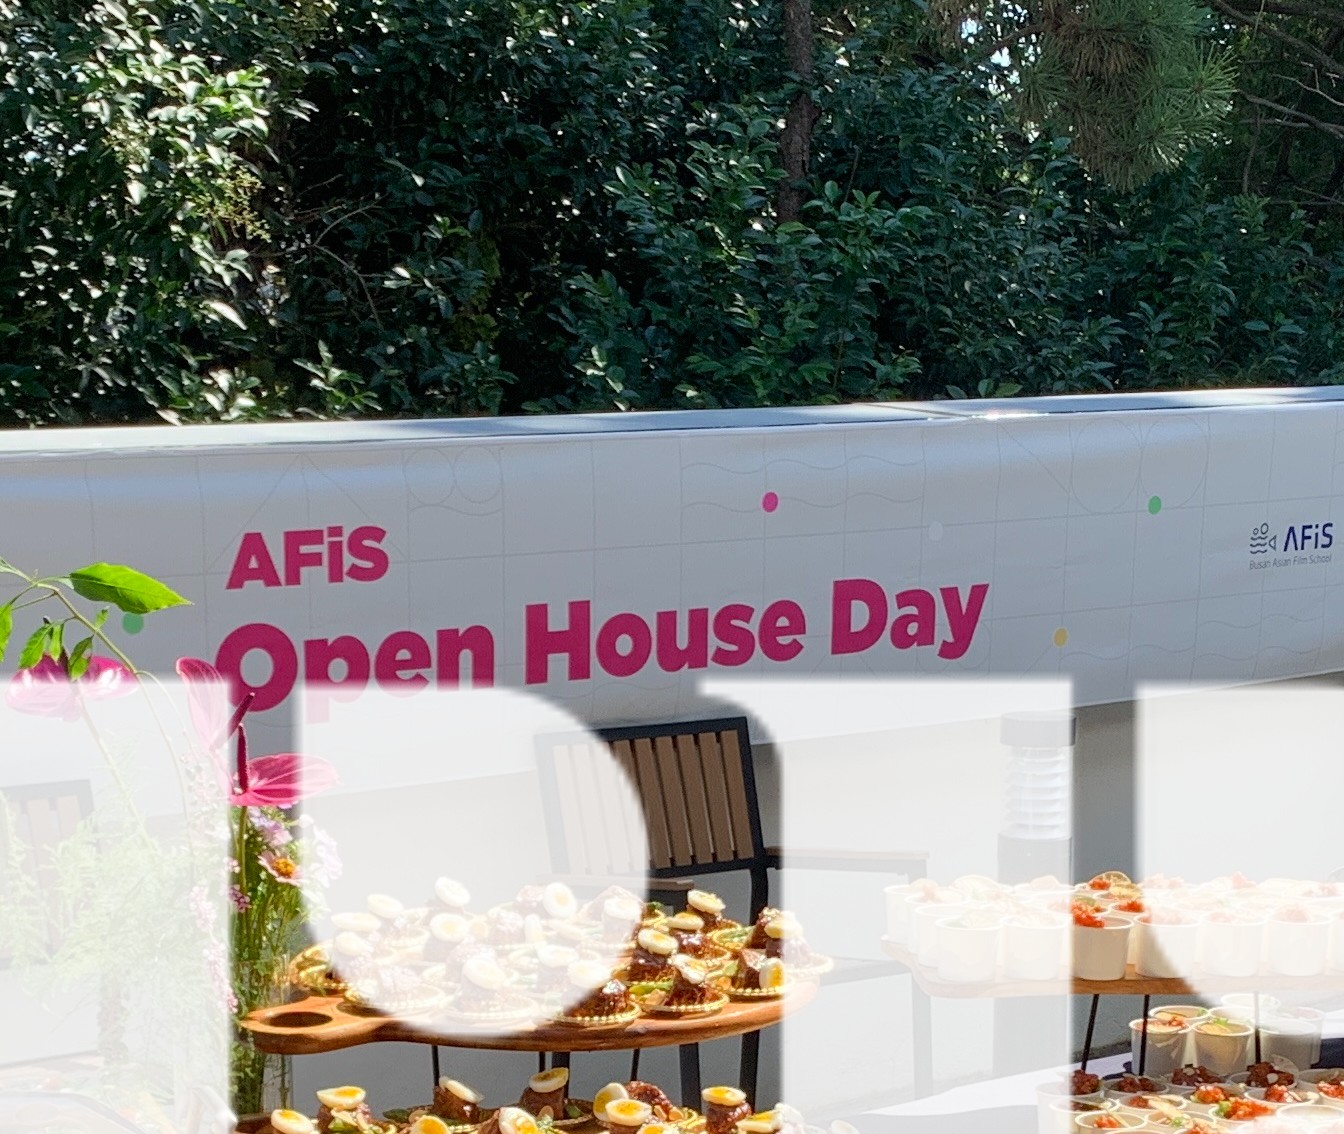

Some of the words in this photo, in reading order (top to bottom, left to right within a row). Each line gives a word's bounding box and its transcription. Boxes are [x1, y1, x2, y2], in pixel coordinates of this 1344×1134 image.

[225, 525, 391, 590] AFiS
[1283, 522, 1334, 552] AFiS
[214, 622, 495, 724] Open
[525, 599, 807, 685] House
[830, 578, 990, 660] Day
